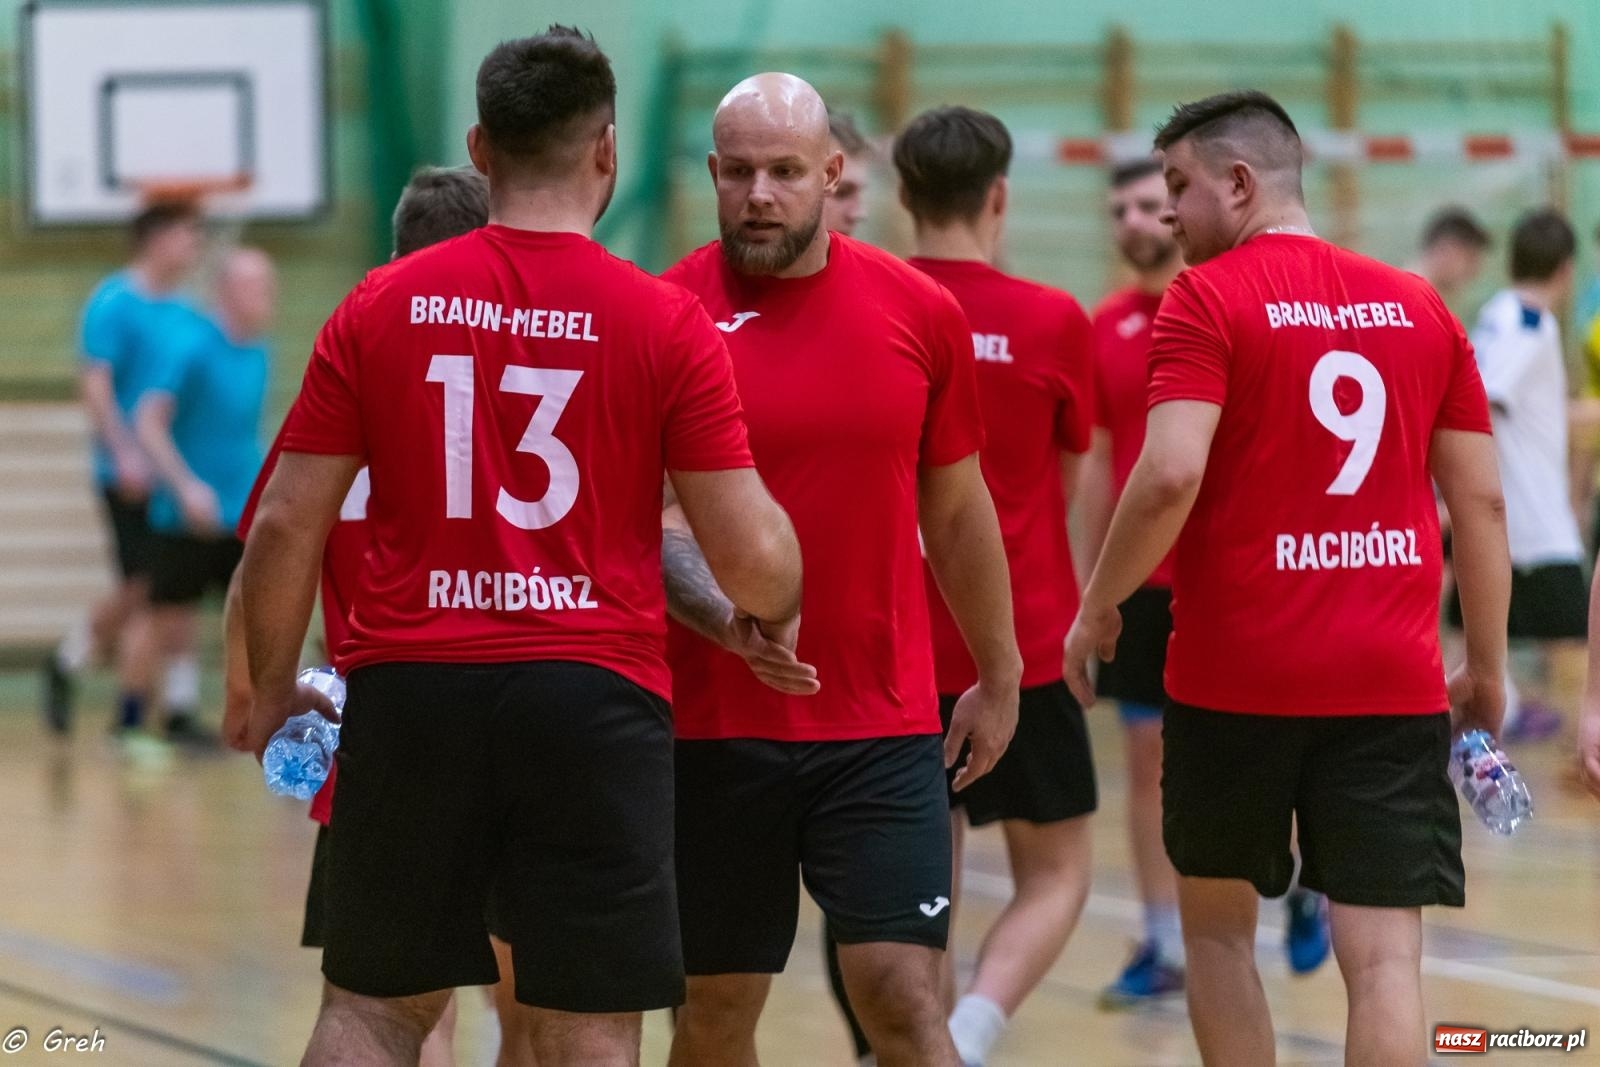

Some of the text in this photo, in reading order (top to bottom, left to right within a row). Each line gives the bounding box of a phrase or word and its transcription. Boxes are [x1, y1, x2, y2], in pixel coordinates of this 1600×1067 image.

[409, 295, 599, 342] BRAUN-MEBEL
[1264, 301, 1415, 331] BRAUN-MEBEL
[425, 354, 584, 531] 13
[1308, 350, 1387, 496] 9
[1275, 521, 1423, 571] RACIBÓRZ
[428, 566, 599, 612] RACIBÓRZ
